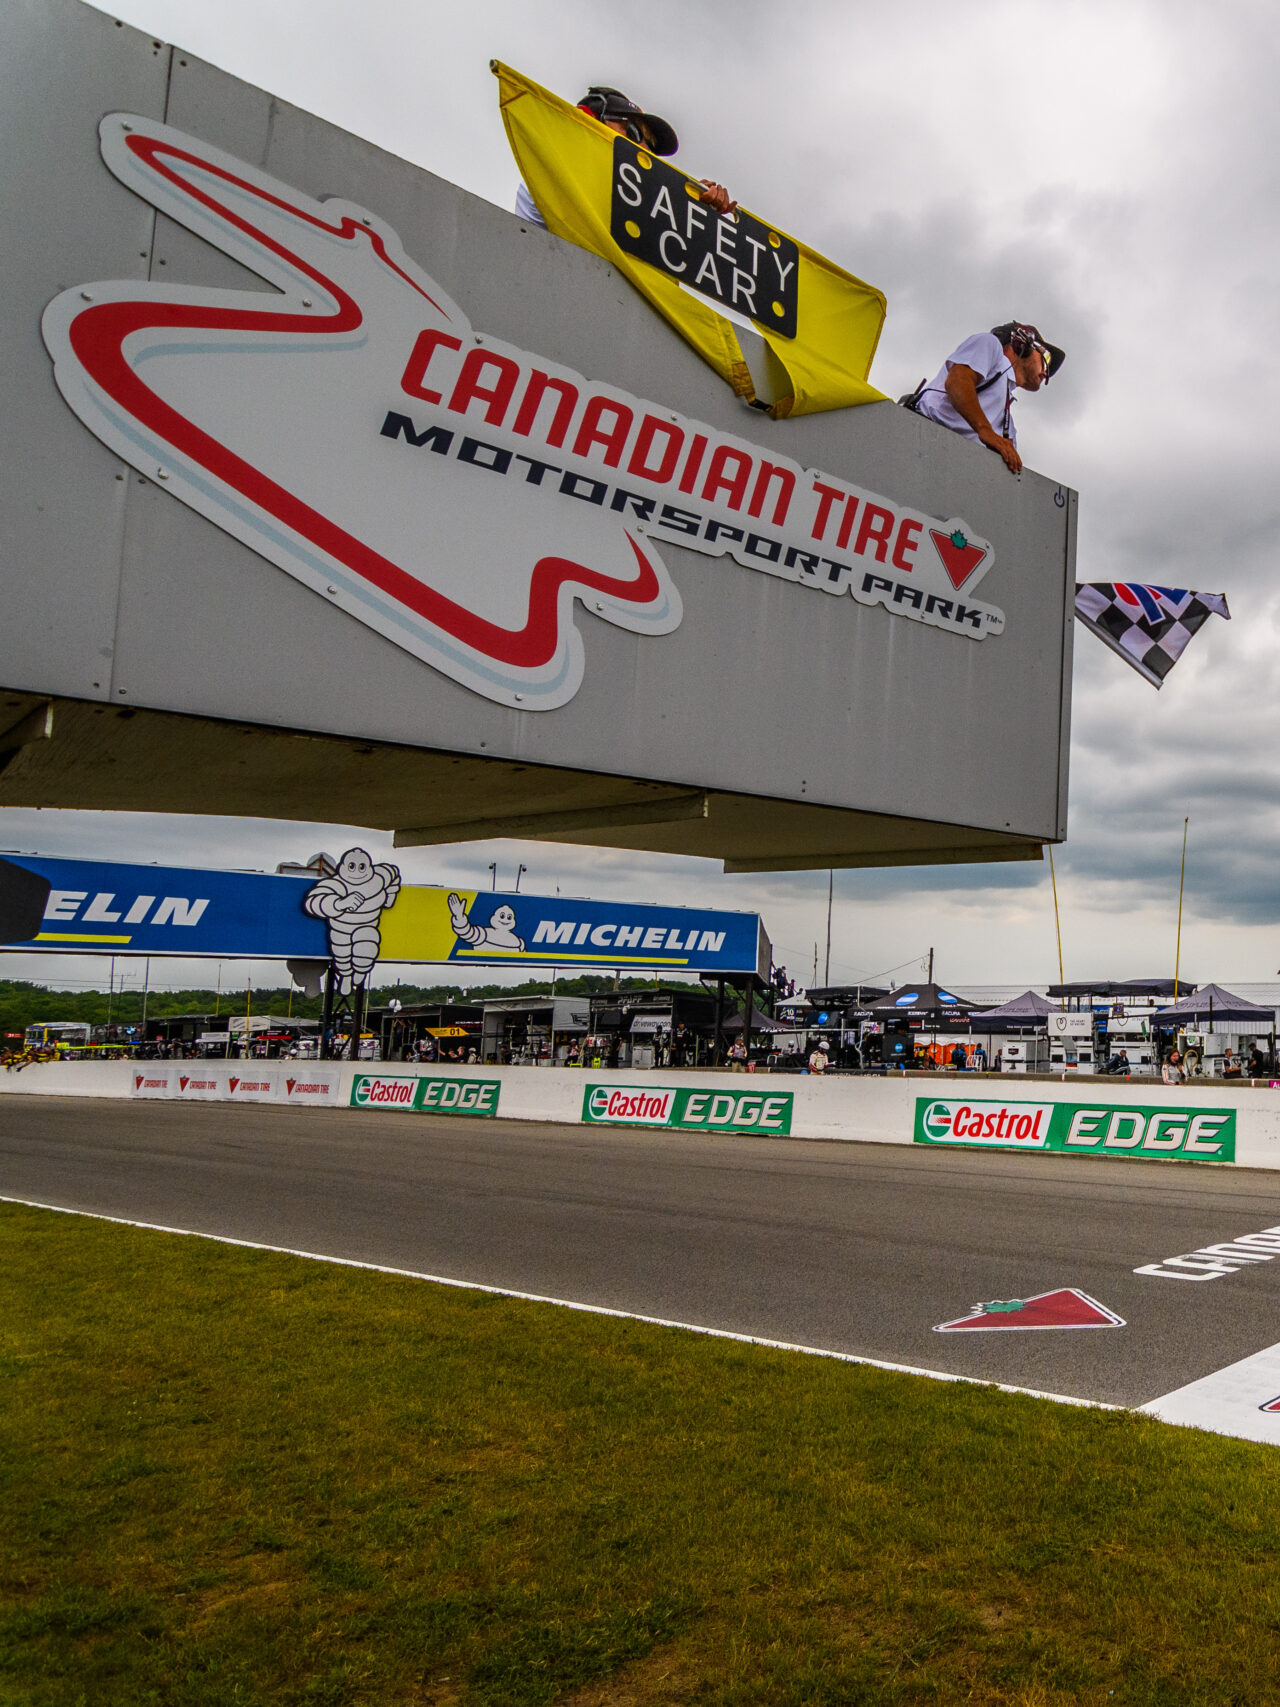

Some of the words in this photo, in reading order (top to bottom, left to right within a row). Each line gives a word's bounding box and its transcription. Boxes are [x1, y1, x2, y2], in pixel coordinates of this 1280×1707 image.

[617, 162, 795, 292] SAFETY
[659, 230, 757, 314] CAR
[401, 329, 796, 527] CANADIAN
[811, 481, 924, 573] TIRE
[380, 411, 852, 582] MOTORSPORT
[532, 920, 726, 952] MICHELIN
[370, 1080, 415, 1103] Castrol
[422, 1082, 498, 1110] EDGE
[607, 1090, 670, 1119] Castrol
[683, 1094, 789, 1128] EDGE
[952, 1106, 1044, 1140] Castrol
[1064, 1110, 1232, 1154] EDGE
